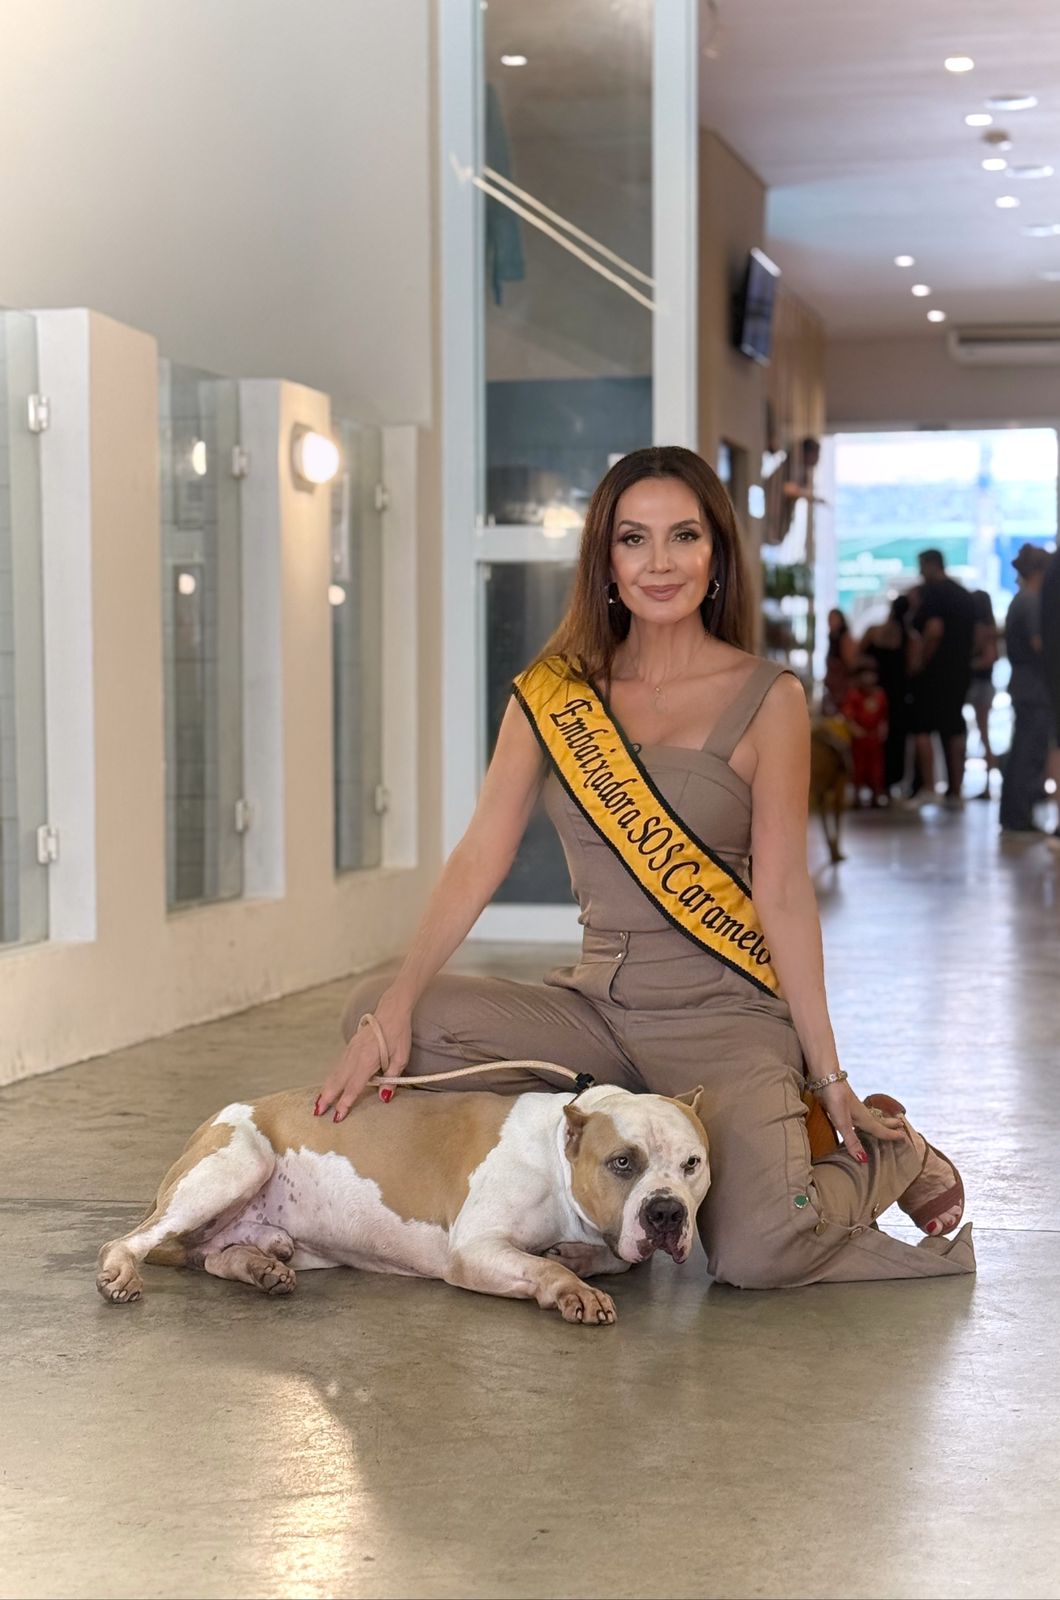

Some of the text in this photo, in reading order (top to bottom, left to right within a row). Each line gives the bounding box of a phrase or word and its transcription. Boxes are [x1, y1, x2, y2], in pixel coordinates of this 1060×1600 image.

[550, 699, 771, 966] Embaixadora SOS Caramelo
